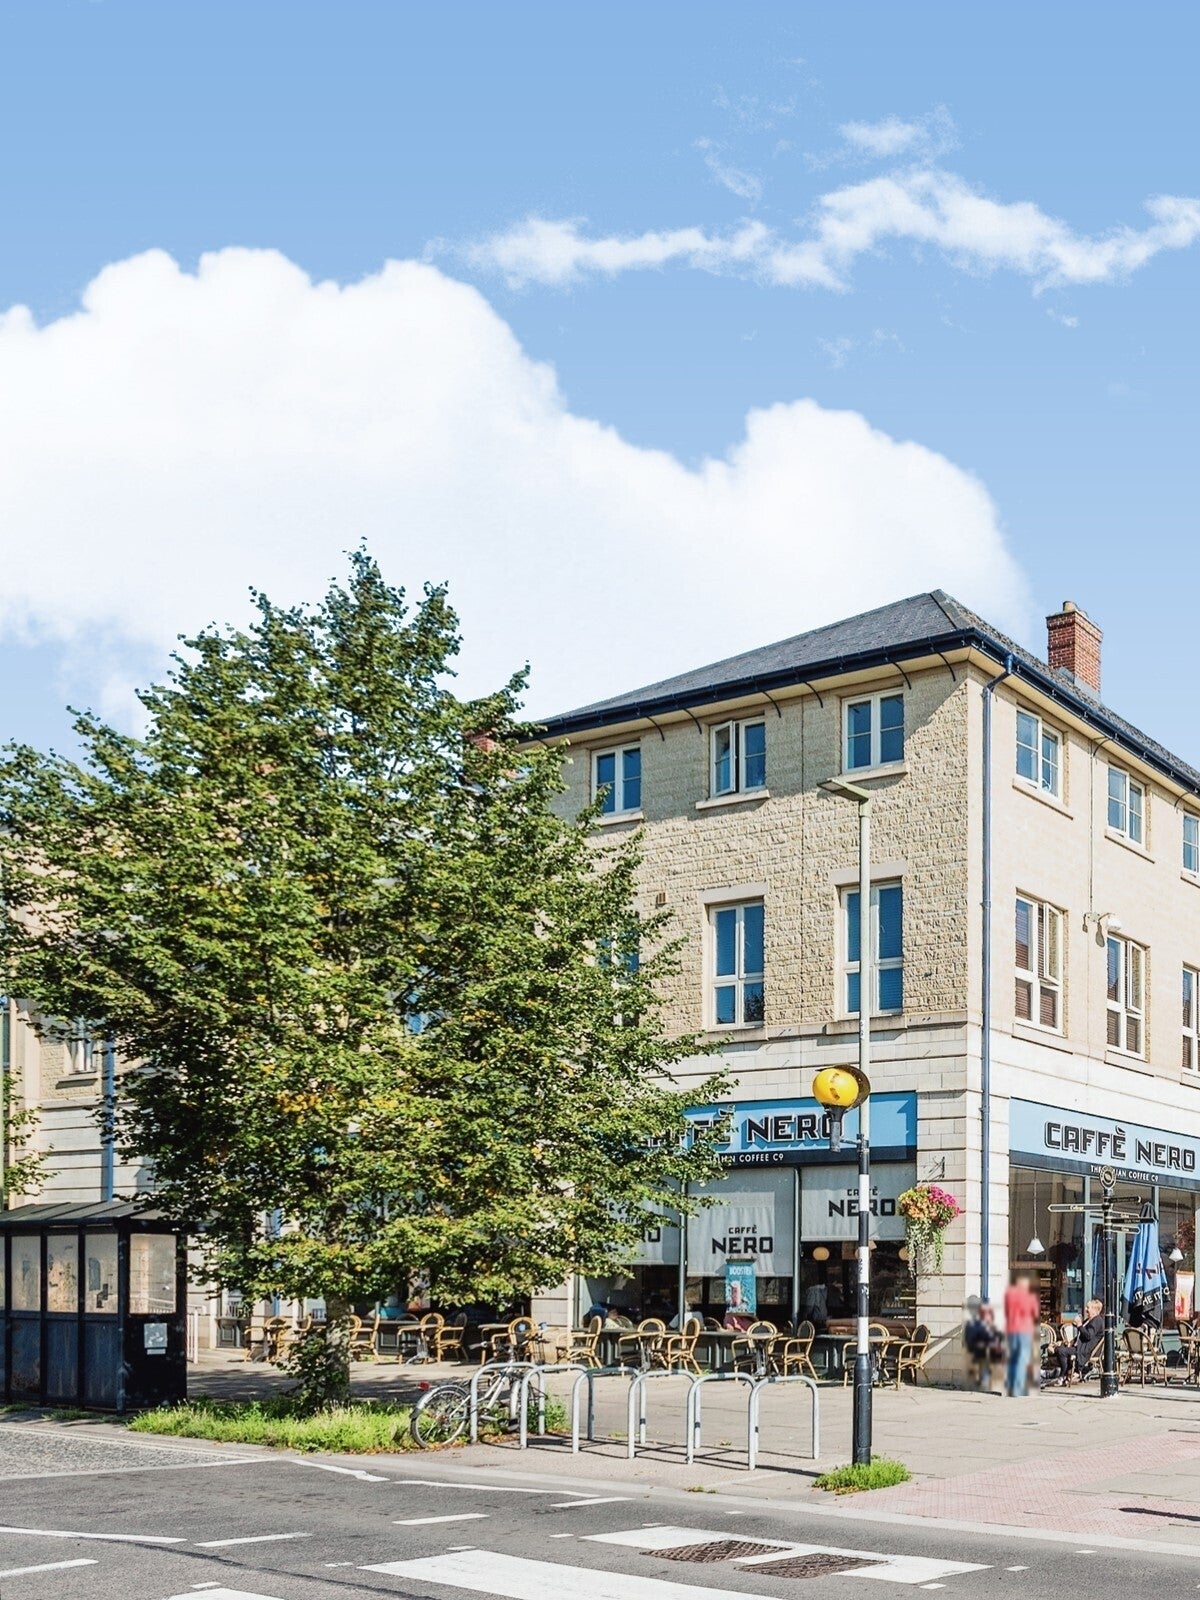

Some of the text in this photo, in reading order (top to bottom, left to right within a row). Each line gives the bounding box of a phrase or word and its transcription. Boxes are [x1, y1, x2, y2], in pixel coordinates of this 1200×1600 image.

[1044, 1121, 1196, 1173] CAFFÈ NERO
[739, 1153, 769, 1163] COFFEE
[1128, 1171, 1150, 1181] COFFEE
[728, 1224, 758, 1235] CAFFÈ
[711, 1236, 774, 1254] NERO
